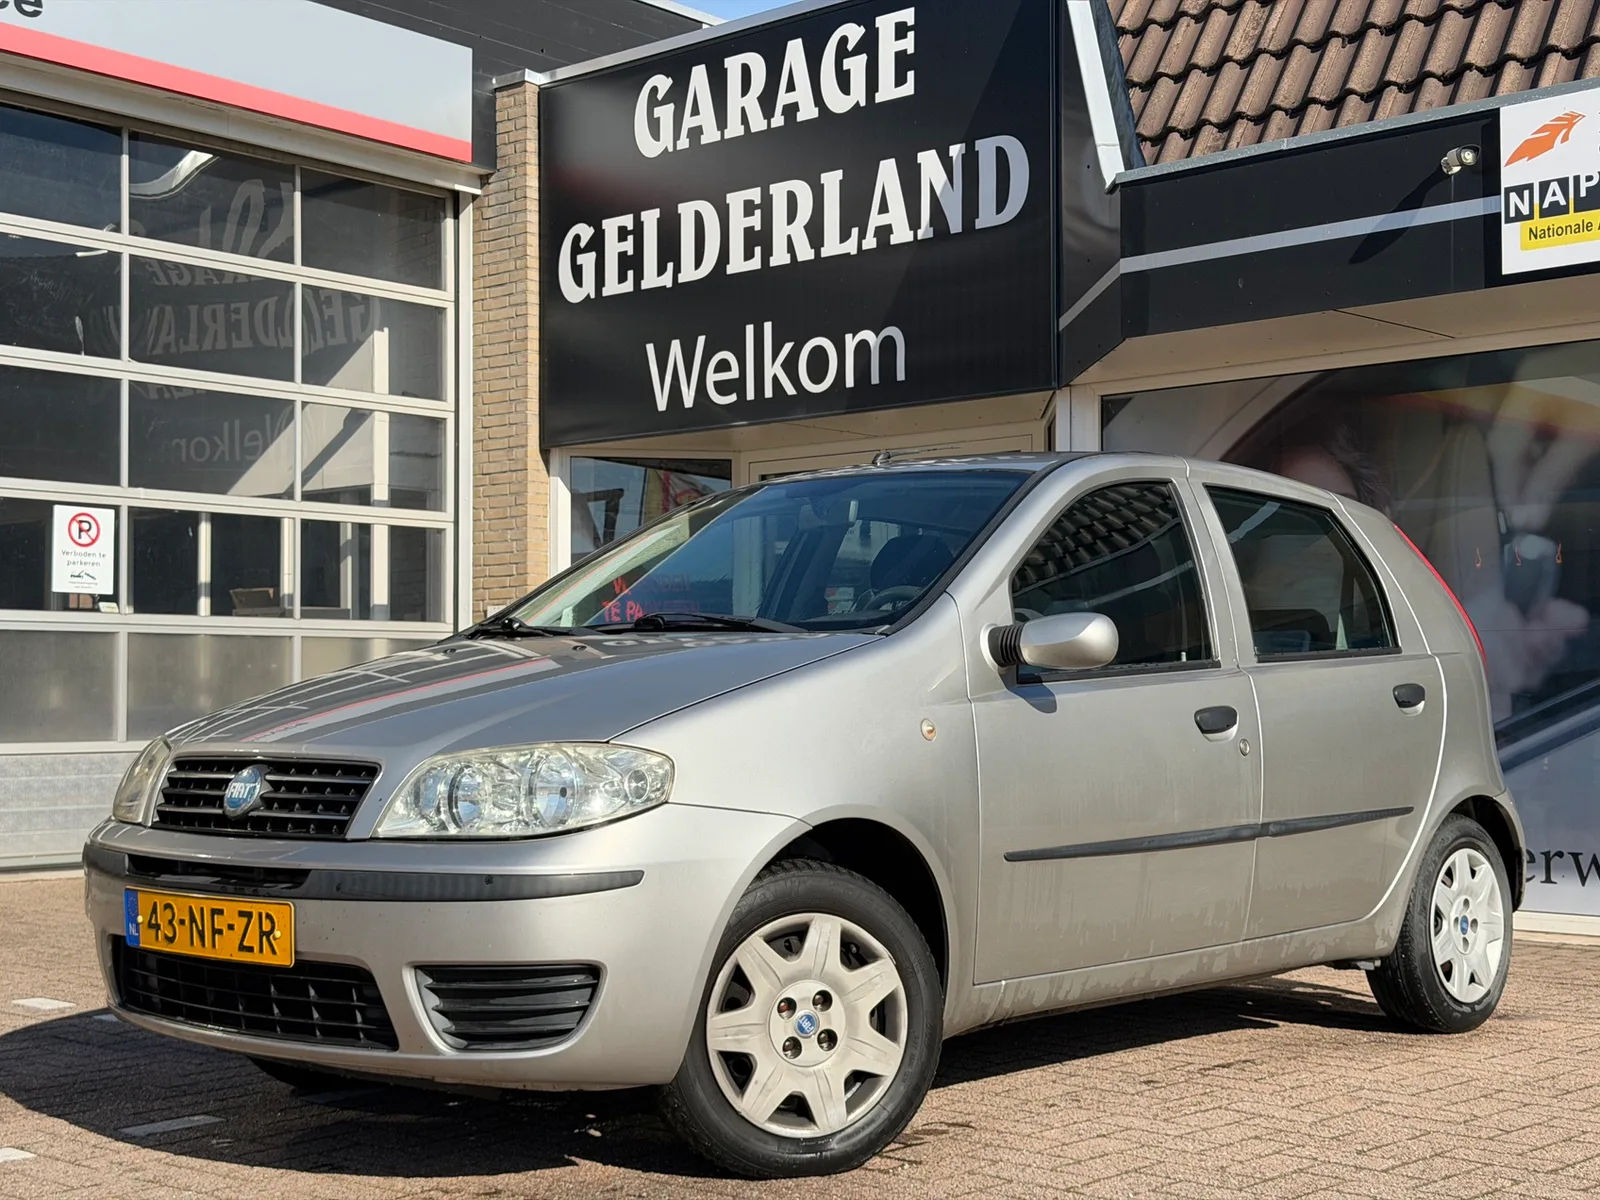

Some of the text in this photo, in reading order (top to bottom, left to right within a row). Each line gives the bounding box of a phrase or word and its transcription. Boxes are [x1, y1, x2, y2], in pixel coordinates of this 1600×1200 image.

[0, 0, 43, 18] e
[633, 6, 915, 159] GARAGE
[1508, 173, 1600, 218] NAP
[557, 134, 1030, 304] GELDERLAND
[1528, 218, 1594, 242] Nationale
[646, 321, 906, 412] Welkom
[61, 549, 97, 558] Verboden
[66, 559, 101, 567] parkeren
[227, 782, 257, 798] FIAT
[128, 922, 139, 936] NL
[148, 901, 278, 955] 43-NF-ZR
